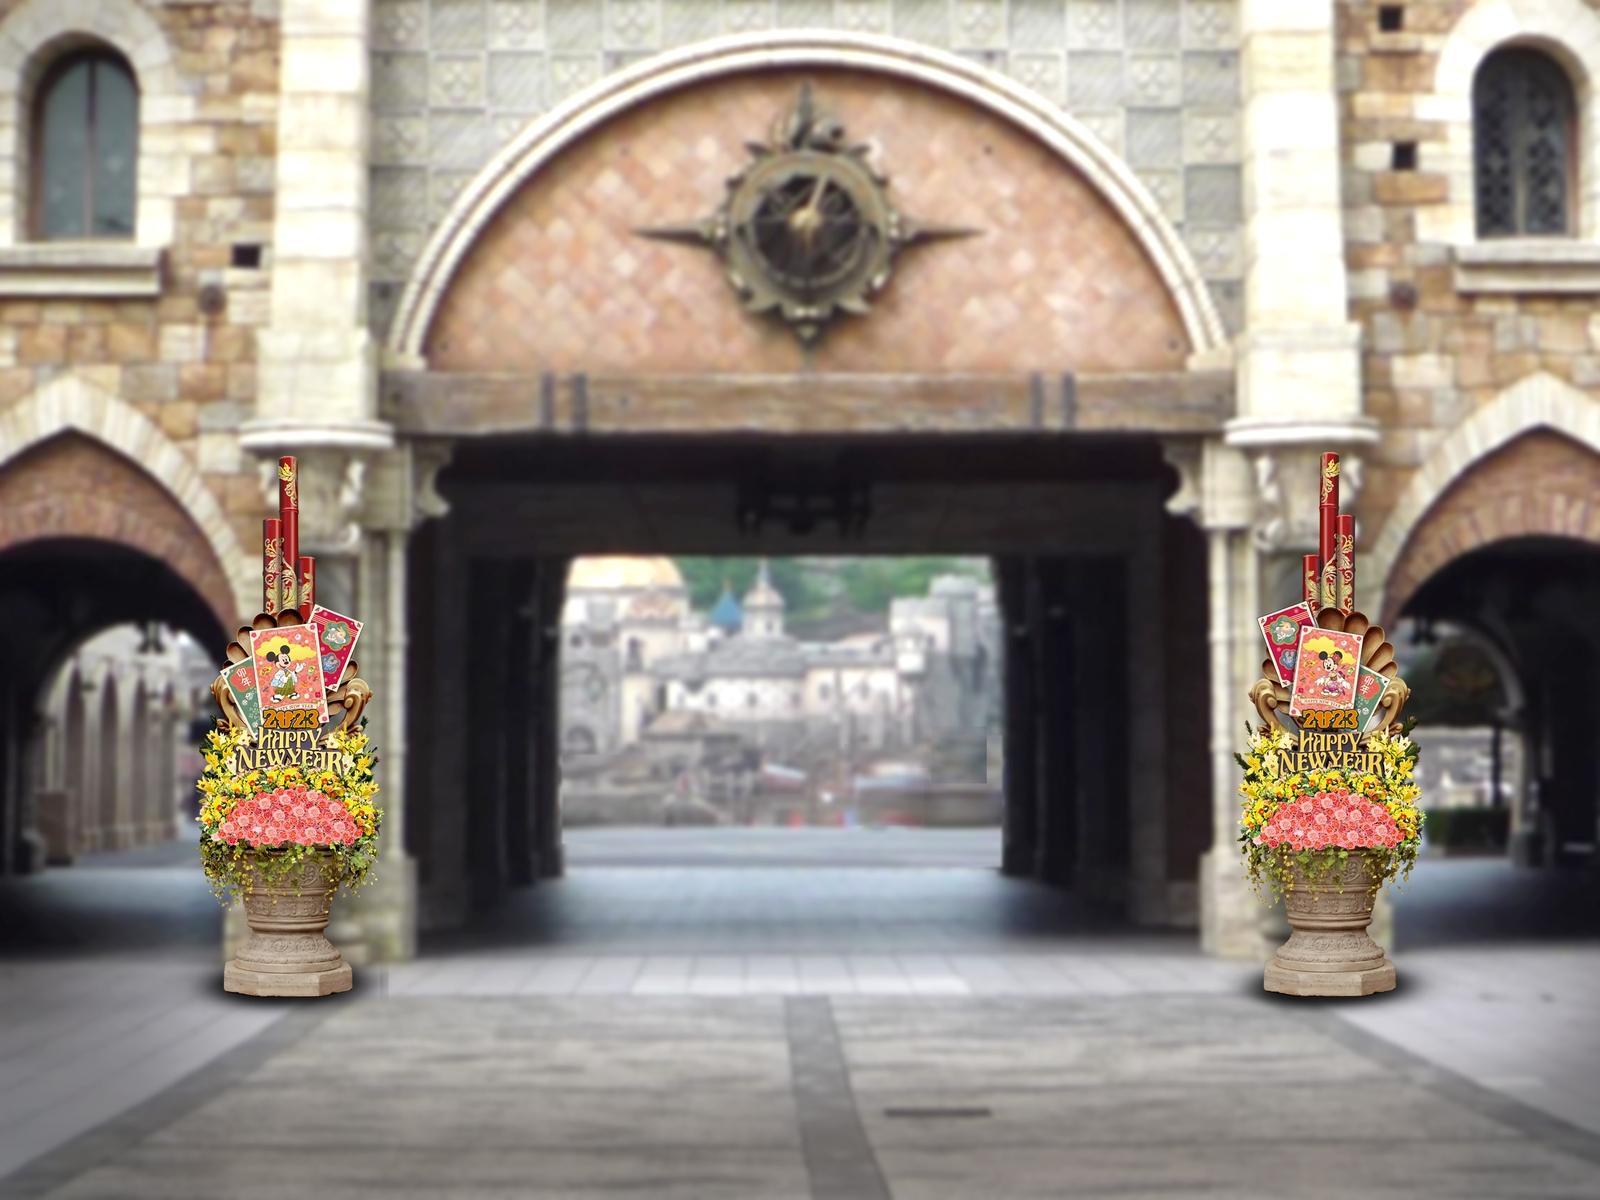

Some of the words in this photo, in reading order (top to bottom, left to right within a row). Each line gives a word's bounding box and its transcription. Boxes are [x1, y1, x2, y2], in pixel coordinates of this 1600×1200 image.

[263, 709, 319, 729] 2023
[1302, 709, 1359, 729] 2023
[258, 727, 322, 751] HAPPY
[1299, 730, 1363, 753] HAPPY
